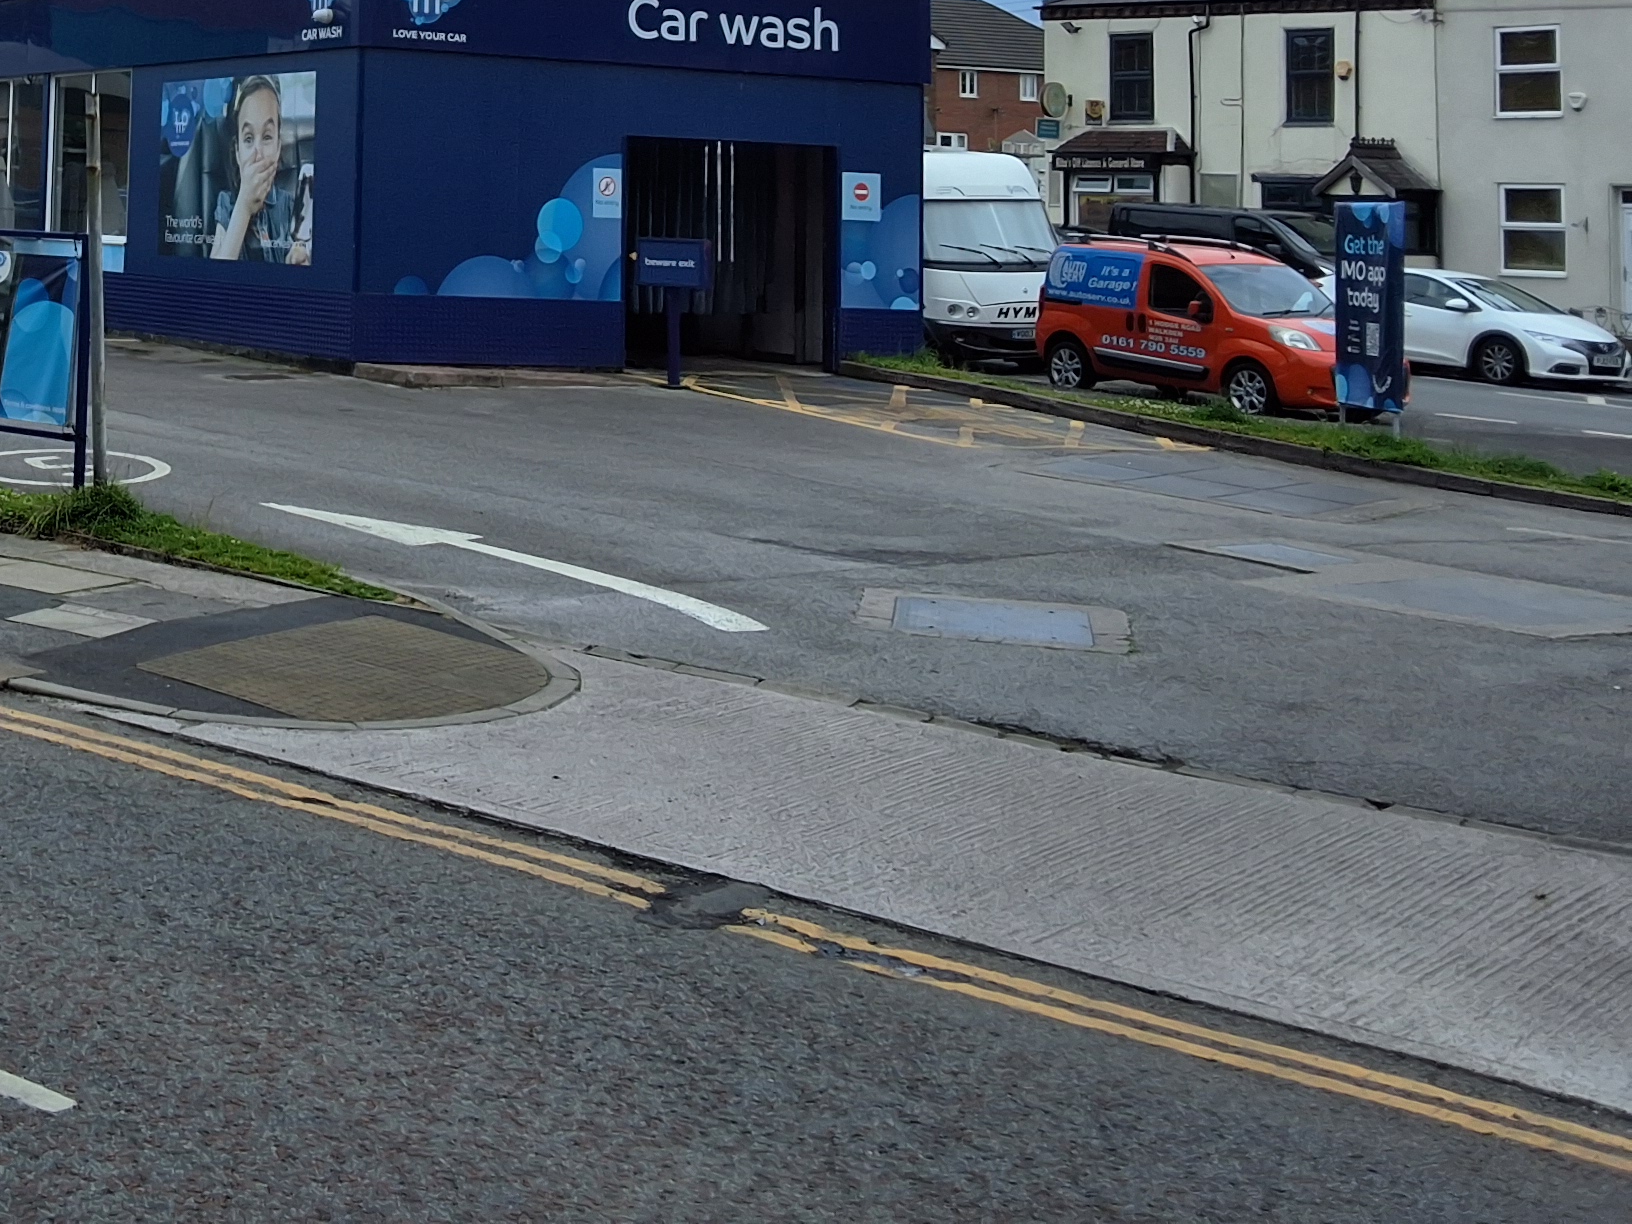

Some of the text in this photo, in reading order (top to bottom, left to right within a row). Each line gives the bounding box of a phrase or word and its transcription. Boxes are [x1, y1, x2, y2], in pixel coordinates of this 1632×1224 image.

[302, 26, 343, 41] CAR WASH
[393, 28, 466, 43] LOVE YOUR CAR
[719, 7, 839, 51] wash
[1344, 234, 1384, 255] Get the
[644, 257, 696, 268] beware exit
[1064, 260, 1087, 274] AUTO
[1101, 265, 1118, 276] It's
[1341, 260, 1386, 286] IMO app
[1063, 273, 1086, 284] SERV
[1347, 287, 1380, 313] today
[1102, 334, 1206, 358] 0161 790 5559
